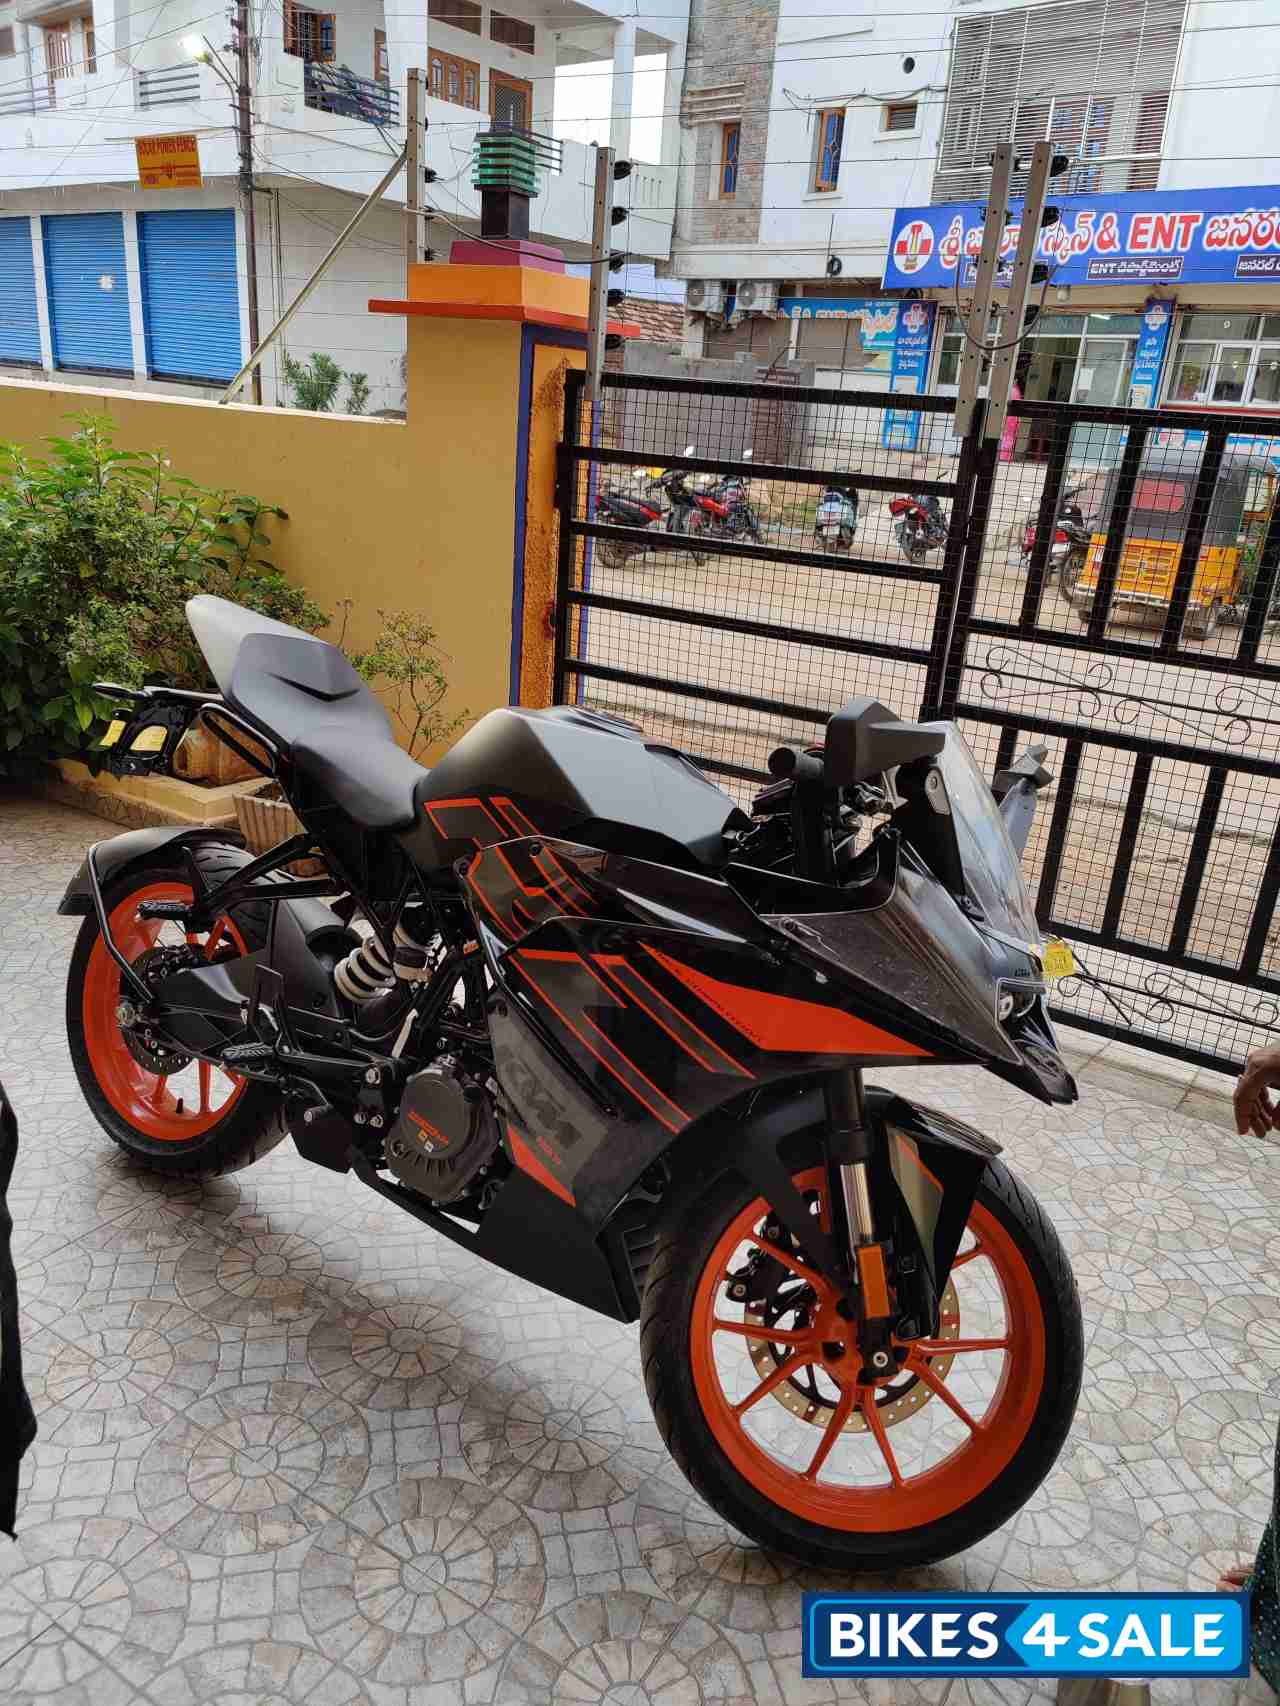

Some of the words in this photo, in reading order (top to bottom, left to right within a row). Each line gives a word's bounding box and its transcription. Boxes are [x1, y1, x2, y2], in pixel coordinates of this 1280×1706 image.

[1096, 213, 1120, 250] &
[1127, 212, 1202, 252] ENT
[1204, 208, 1280, 249] జనర
[1090, 262, 1117, 274] ENT
